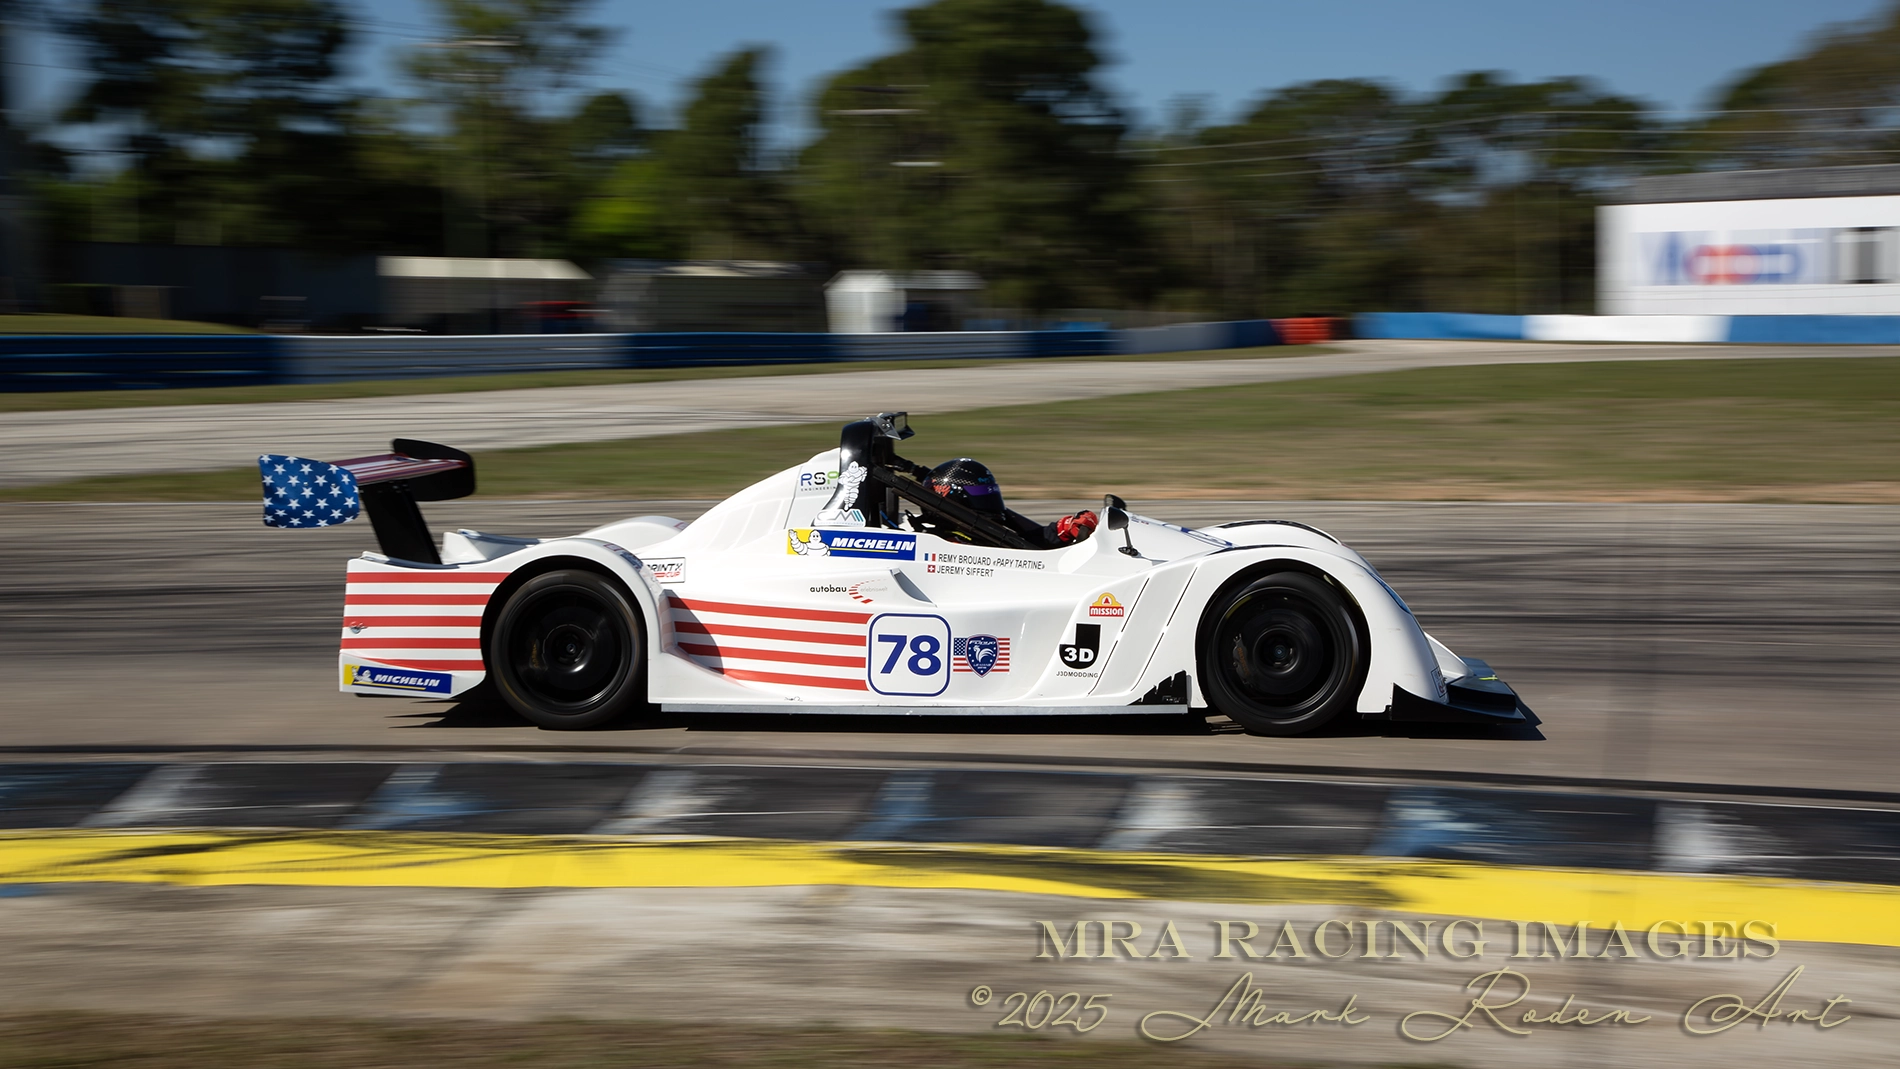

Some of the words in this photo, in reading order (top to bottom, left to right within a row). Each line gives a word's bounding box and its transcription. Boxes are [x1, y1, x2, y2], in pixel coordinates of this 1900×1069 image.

[801, 471, 839, 486] RSP
[831, 537, 915, 551] MICHELIN
[938, 553, 957, 563] REMY
[958, 555, 991, 566] BROUARD
[937, 565, 964, 575] JEREMY
[966, 567, 994, 577] SIFFERT
[810, 584, 847, 592] autobau
[878, 634, 942, 676] 78
[1063, 647, 1094, 662] 3D
[374, 674, 440, 688] MICHELIN
